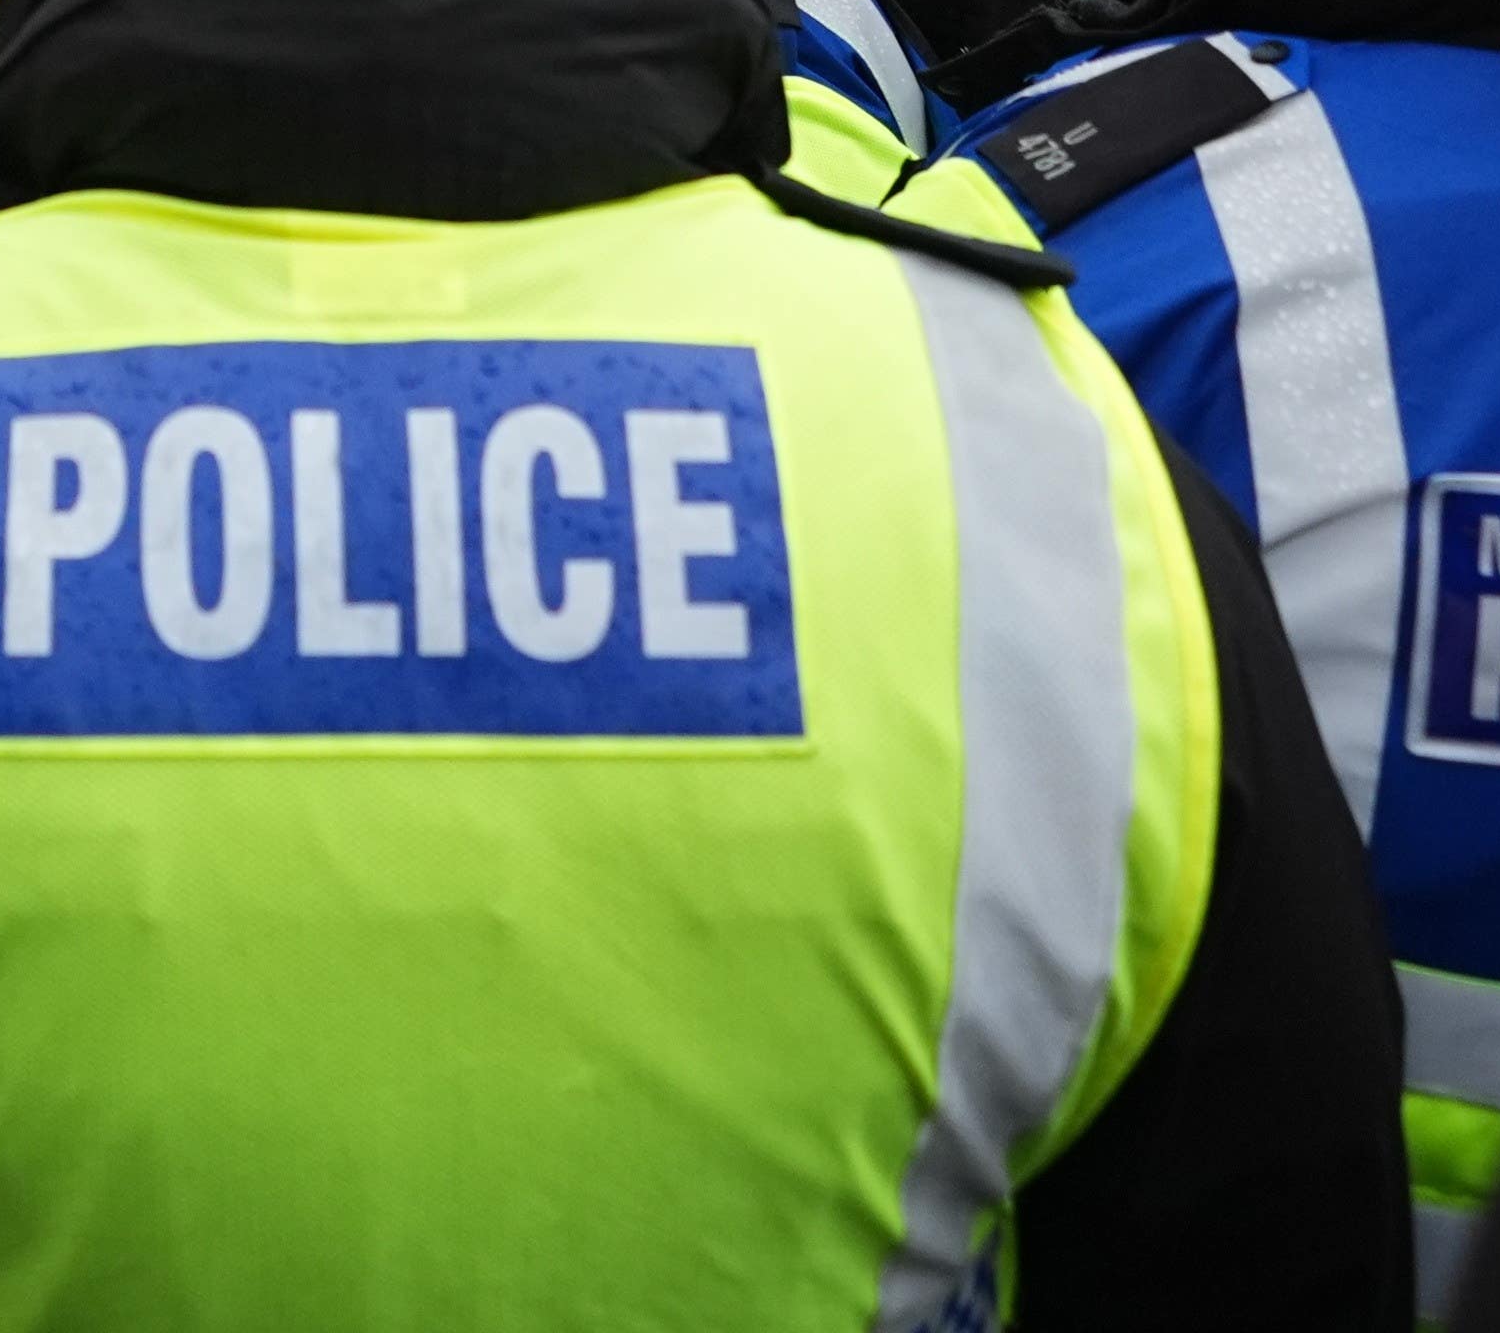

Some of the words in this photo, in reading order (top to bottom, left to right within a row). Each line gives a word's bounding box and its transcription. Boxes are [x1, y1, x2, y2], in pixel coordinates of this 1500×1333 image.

[1018, 132, 1077, 182] 4781
[1063, 121, 1098, 146] U
[3, 403, 751, 662] POLICE
